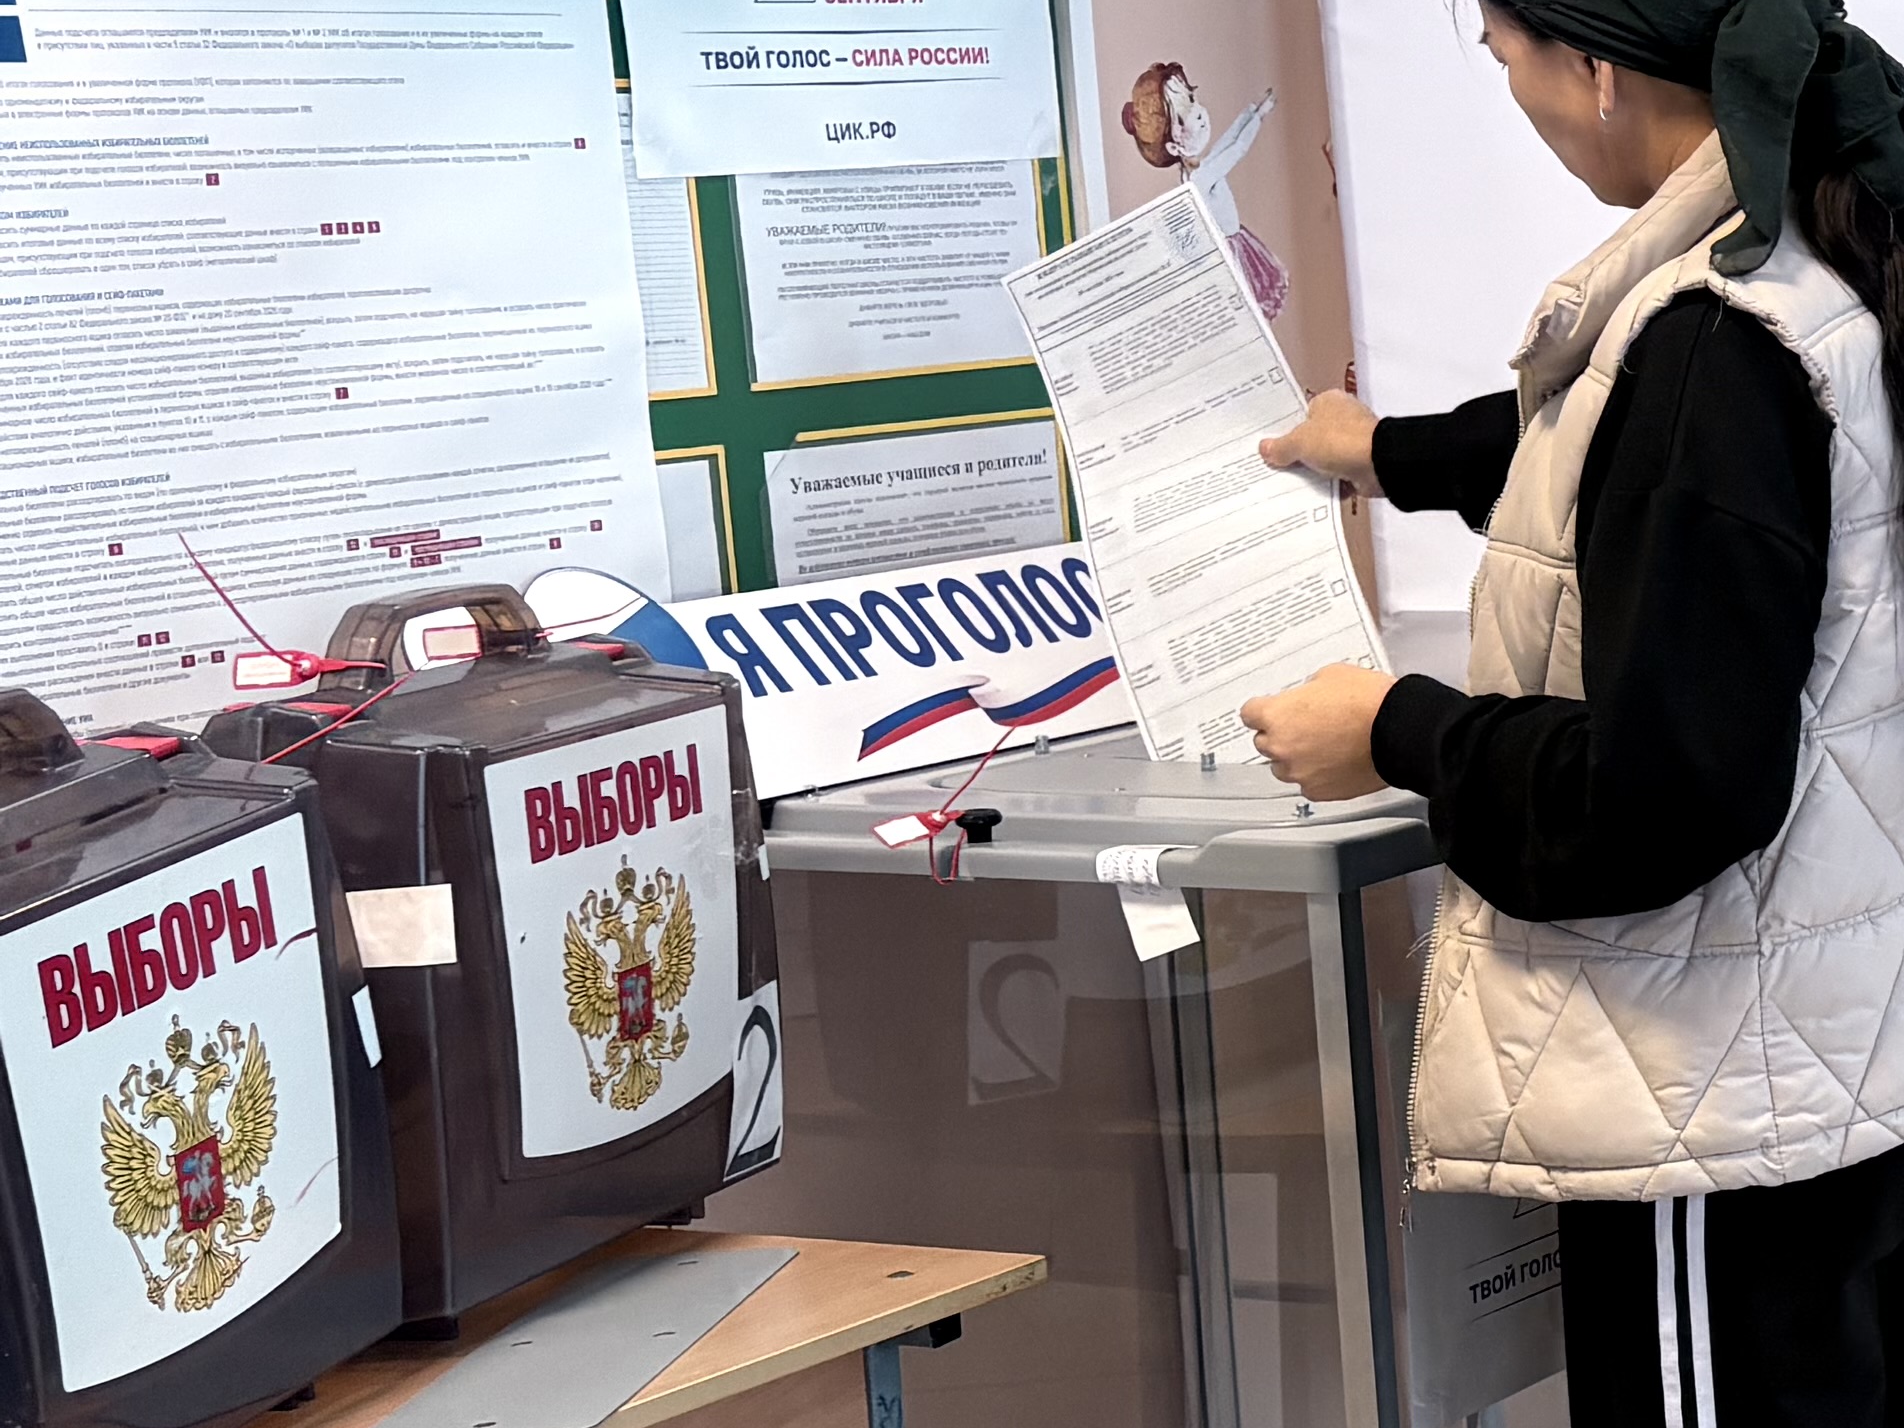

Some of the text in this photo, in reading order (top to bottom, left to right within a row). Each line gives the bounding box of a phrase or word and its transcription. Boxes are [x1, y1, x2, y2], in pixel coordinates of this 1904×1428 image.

[700, 46, 761, 71] ТВОЙ
[764, 47, 832, 70] ГОЛОС
[852, 46, 904, 69] СИЛА
[907, 44, 990, 68] РОССИИ!
[824, 119, 898, 144] ЦИК.РФ
[790, 473, 884, 494] Уважаемые
[887, 461, 961, 488] учащиеся
[977, 448, 1048, 477] родители!
[705, 613, 794, 698] Я
[522, 742, 704, 865] ВЫБОРЫ
[37, 866, 278, 1049] ВЫБОРЫ
[735, 1003, 781, 1173] 2
[1469, 1249, 1561, 1304] ТВОЙ ГОЛО
